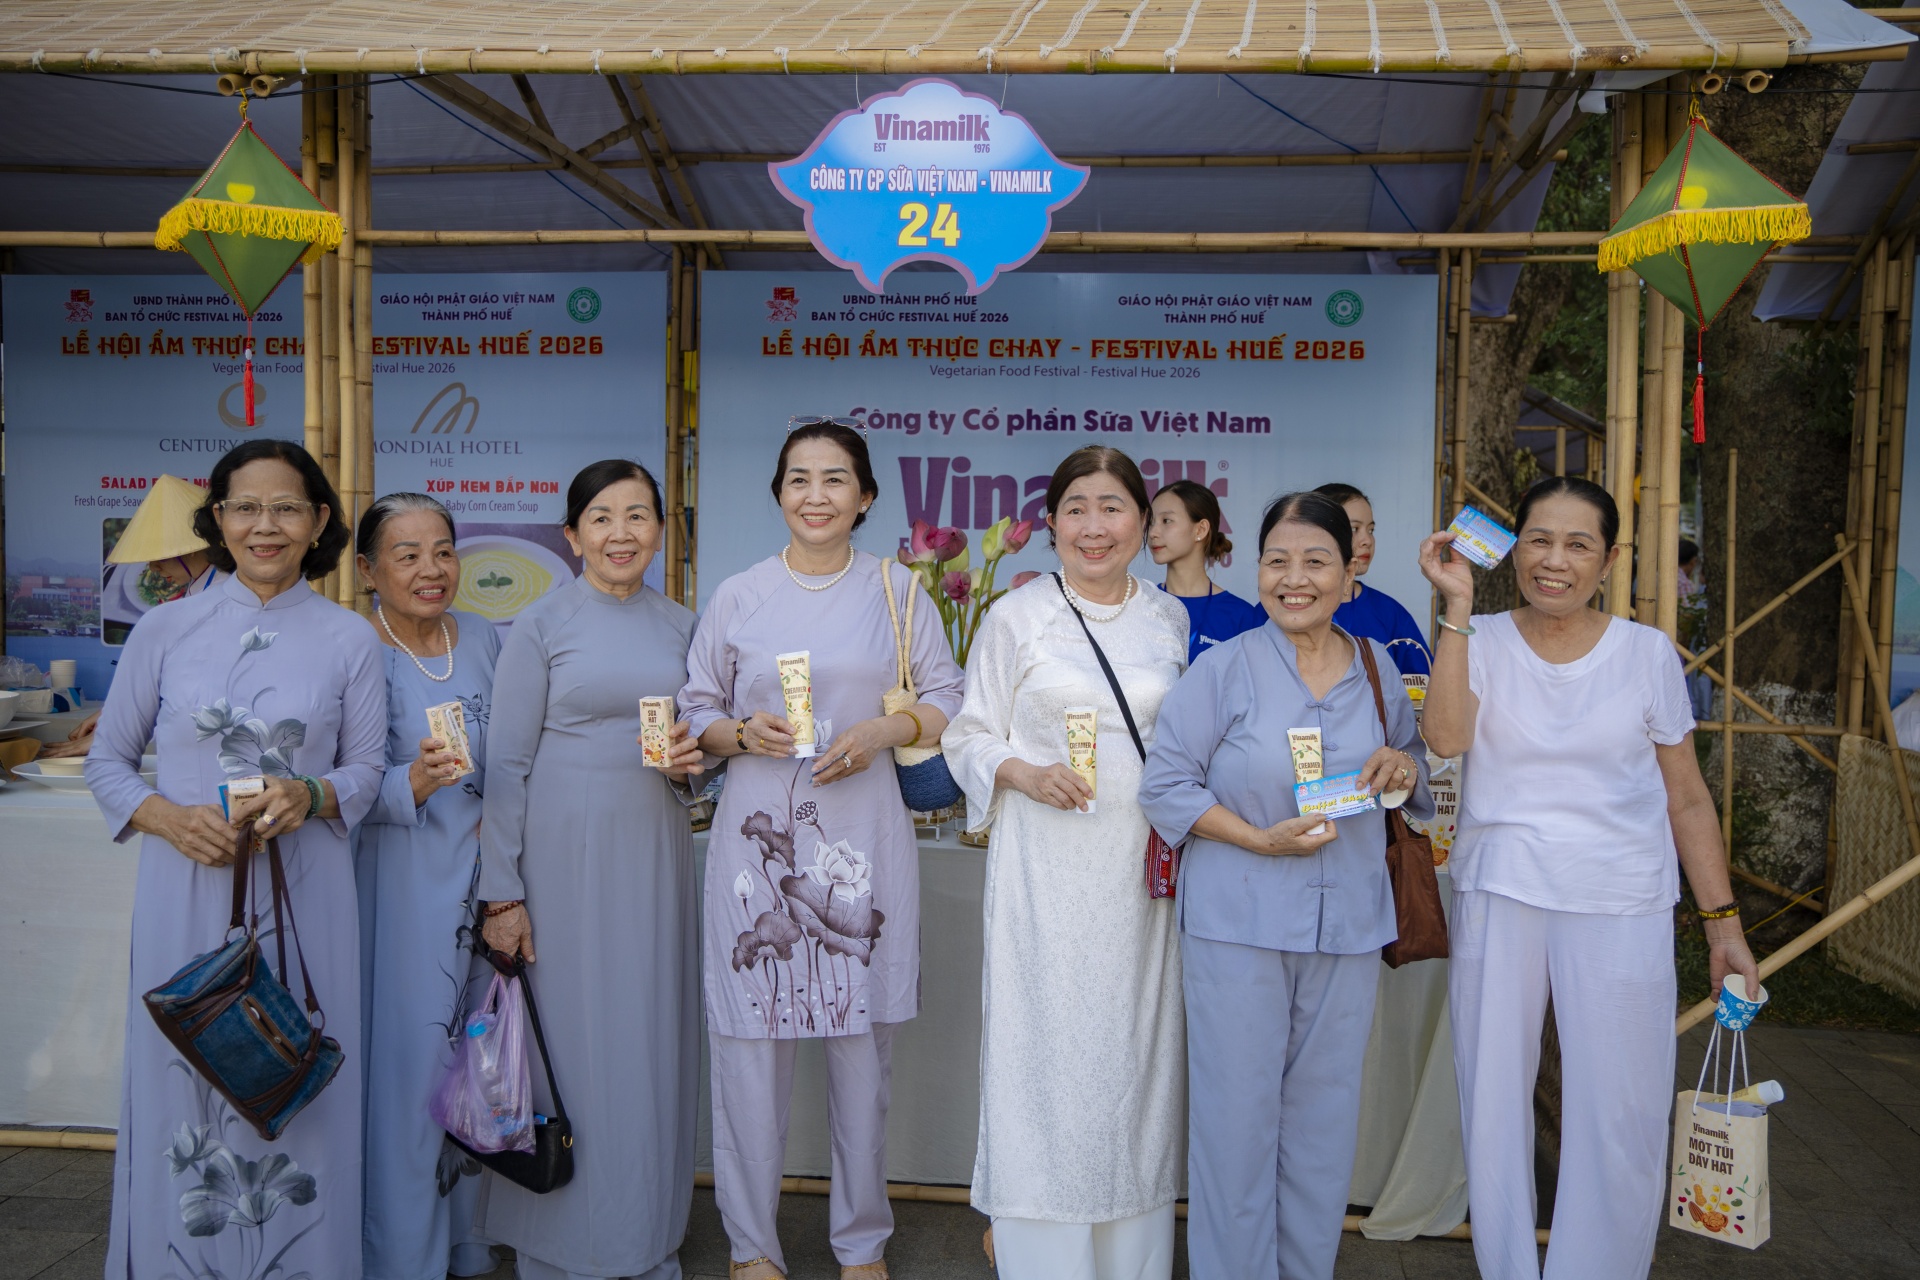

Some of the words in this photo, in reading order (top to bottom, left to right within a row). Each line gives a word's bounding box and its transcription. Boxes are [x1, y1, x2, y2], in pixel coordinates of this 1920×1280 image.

[874, 114, 990, 142] Vinamilk
[874, 142, 886, 152] EST
[974, 143, 990, 154] 1976
[810, 164, 846, 191] CÔNG
[849, 168, 864, 191] TY
[867, 168, 884, 192] CP
[888, 165, 914, 192] SỮA
[917, 166, 945, 197] VIỆT
[948, 170, 978, 193] NAM
[990, 170, 1052, 194] VINAMILK
[898, 202, 961, 247] 24
[133, 296, 163, 306] UBND
[165, 294, 203, 306] THÀNH
[380, 292, 410, 304] GIÁO
[413, 292, 434, 307] HỘI
[437, 292, 466, 307] PHẬT
[469, 292, 500, 304] GIÁO
[502, 292, 526, 306] VIỆT
[528, 294, 555, 304] NAM
[843, 295, 876, 305] UBND
[880, 292, 921, 305] THÀNH
[924, 291, 951, 305] PHỐ
[1118, 294, 1151, 306] GIÁO
[1155, 294, 1179, 309] HỘI
[1182, 294, 1214, 309] PHẬT
[1216, 294, 1250, 306] GIÁO
[1254, 294, 1281, 310] VIỆT
[1283, 296, 1312, 307] NAM
[105, 312, 129, 322] BAN
[130, 308, 146, 322] TỔ
[148, 309, 181, 322] CHỨC
[184, 312, 230, 322] FESTIVAL
[232, 312, 253, 322] HU
[256, 312, 283, 322] 2026
[422, 308, 460, 321] THÀNH
[464, 307, 488, 321] PHỐ
[491, 307, 515, 320] HUẾ
[811, 312, 836, 322] BAN
[839, 306, 855, 322] TỔ
[858, 308, 896, 322] CHỨC
[899, 312, 950, 322] FESTIVAL
[953, 308, 979, 322] HUẾ
[980, 312, 1009, 322] 2026
[1164, 310, 1206, 324] THÀNH
[1210, 310, 1237, 324] PHỐ
[1240, 310, 1268, 324] HUẾ
[61, 329, 90, 355] LỄ
[98, 332, 140, 359] HỘI
[148, 329, 184, 356] ẨM
[192, 334, 256, 360] THỰC
[372, 336, 471, 356] ESTIVAL
[478, 330, 532, 356] HUẾ
[540, 336, 604, 356] 2026
[762, 329, 794, 356] LỄ
[802, 332, 850, 361] HỘI
[858, 329, 898, 357] ẨM
[906, 335, 979, 362] THỰC
[988, 338, 1062, 358] CHAY
[1090, 339, 1218, 360] FESTIVAL
[1226, 333, 1287, 360] HUẾ
[1294, 340, 1365, 360] 2026
[275, 362, 303, 374] Food
[402, 362, 424, 374] Hue
[428, 362, 456, 374] 2026
[930, 364, 996, 378] Vegetarian
[1000, 364, 1030, 377] Food
[1034, 364, 1080, 378] Festival
[1091, 366, 1137, 378] Festival
[1142, 366, 1166, 378] Hue
[1170, 366, 1200, 378] 2026
[850, 407, 922, 435] Công
[928, 410, 956, 435] ty
[962, 407, 1000, 430] Cổ
[1006, 408, 1076, 436] phần
[1084, 410, 1132, 432] Sữa
[1140, 410, 1199, 437] Việt
[1206, 412, 1271, 434] Nam
[159, 438, 240, 452] CENTURY
[460, 441, 523, 454] HOTEL
[430, 458, 454, 468] HUE
[102, 476, 146, 488] SALAD
[426, 477, 455, 492] XÚP
[460, 480, 490, 493] KEM
[496, 475, 524, 494] BẮP
[530, 481, 559, 494] NON
[74, 495, 96, 507] Fresh
[98, 496, 120, 509] Grape
[446, 500, 466, 513] Baby
[468, 500, 486, 512] Corn
[489, 500, 516, 512] Cream
[518, 500, 538, 514] Soup
[780, 658, 806, 667] Vinamilk
[784, 686, 806, 695] CREAMER
[1298, 762, 1320, 770] CREAMER
[1428, 779, 1453, 787] namilk
[1693, 1122, 1730, 1140] Vinamilk
